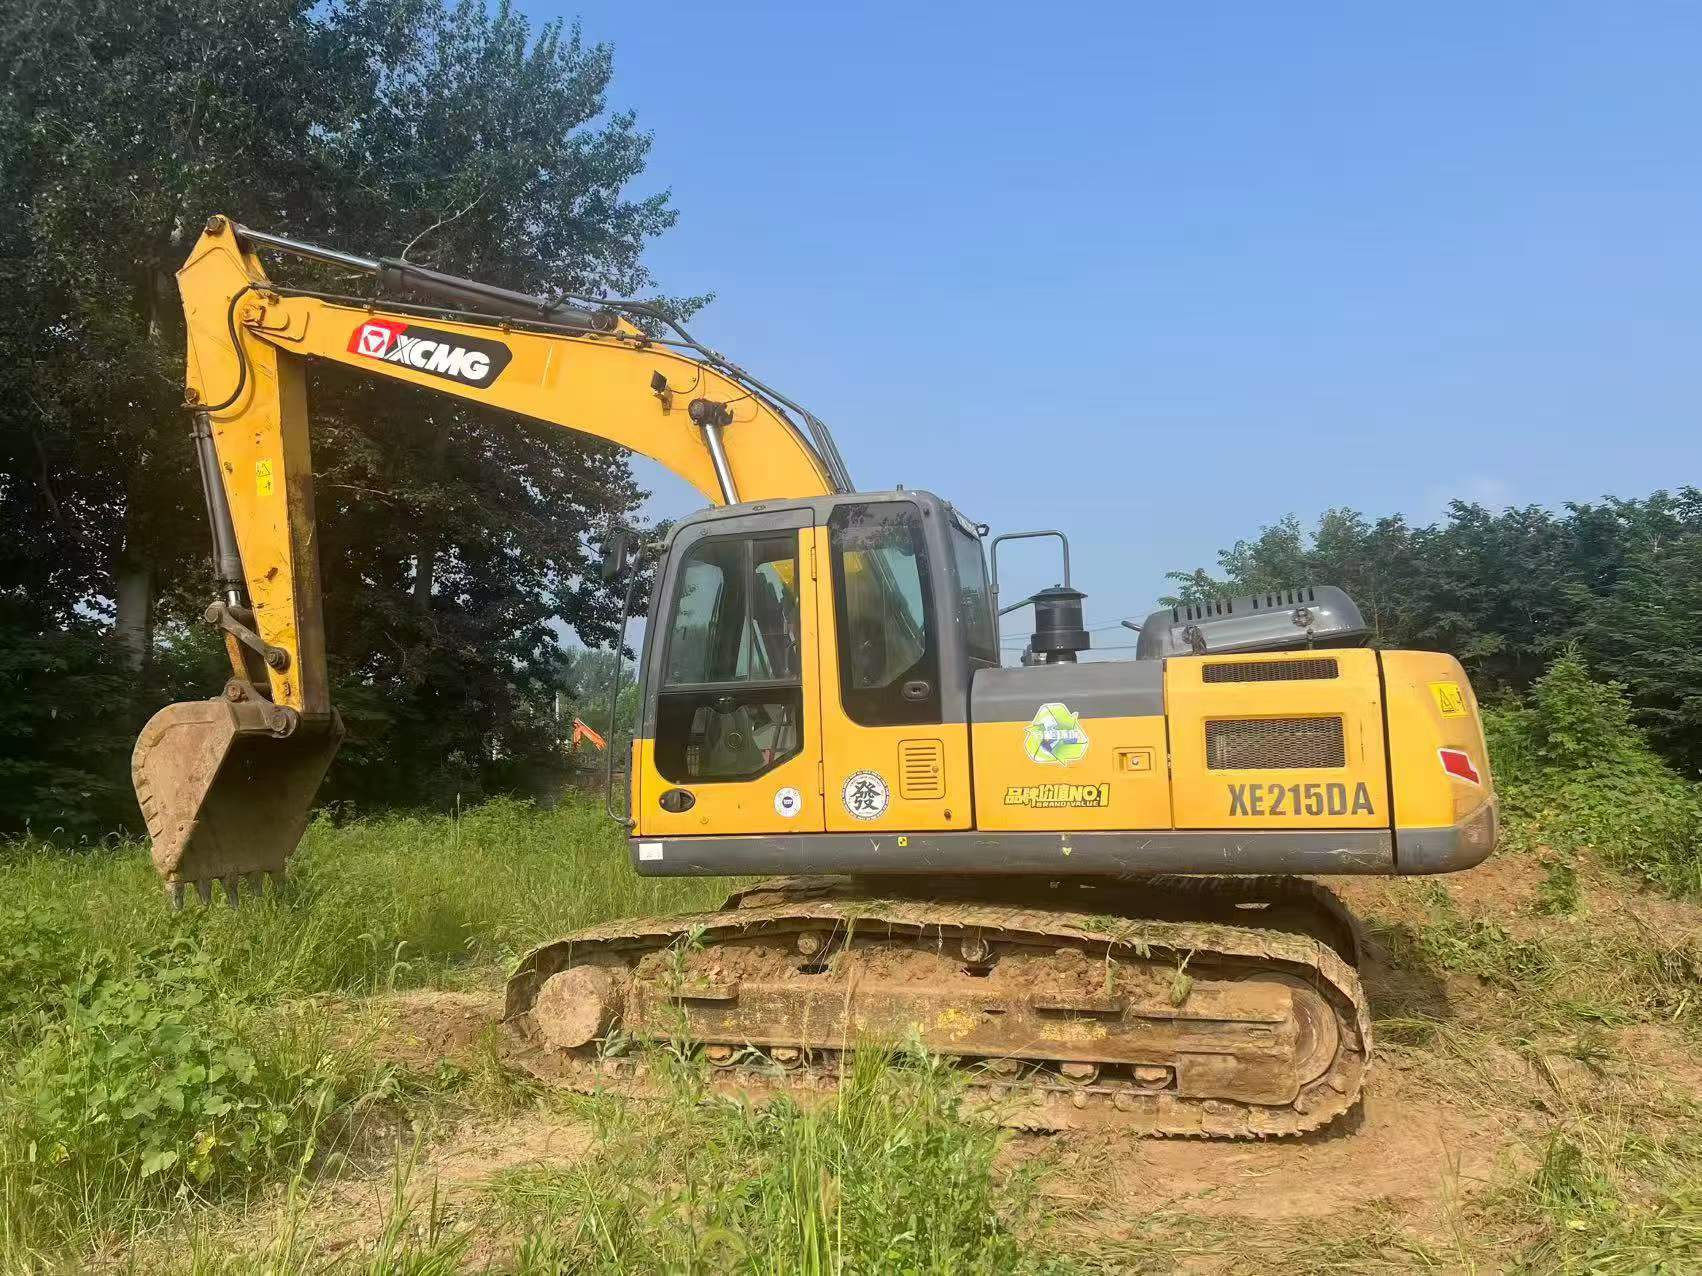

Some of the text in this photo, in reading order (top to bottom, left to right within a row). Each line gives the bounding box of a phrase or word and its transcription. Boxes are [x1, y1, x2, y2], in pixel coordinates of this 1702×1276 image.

[385, 334, 491, 380] XCMG
[850, 780, 881, 810] 發
[1228, 782, 1375, 816] XE215DA
